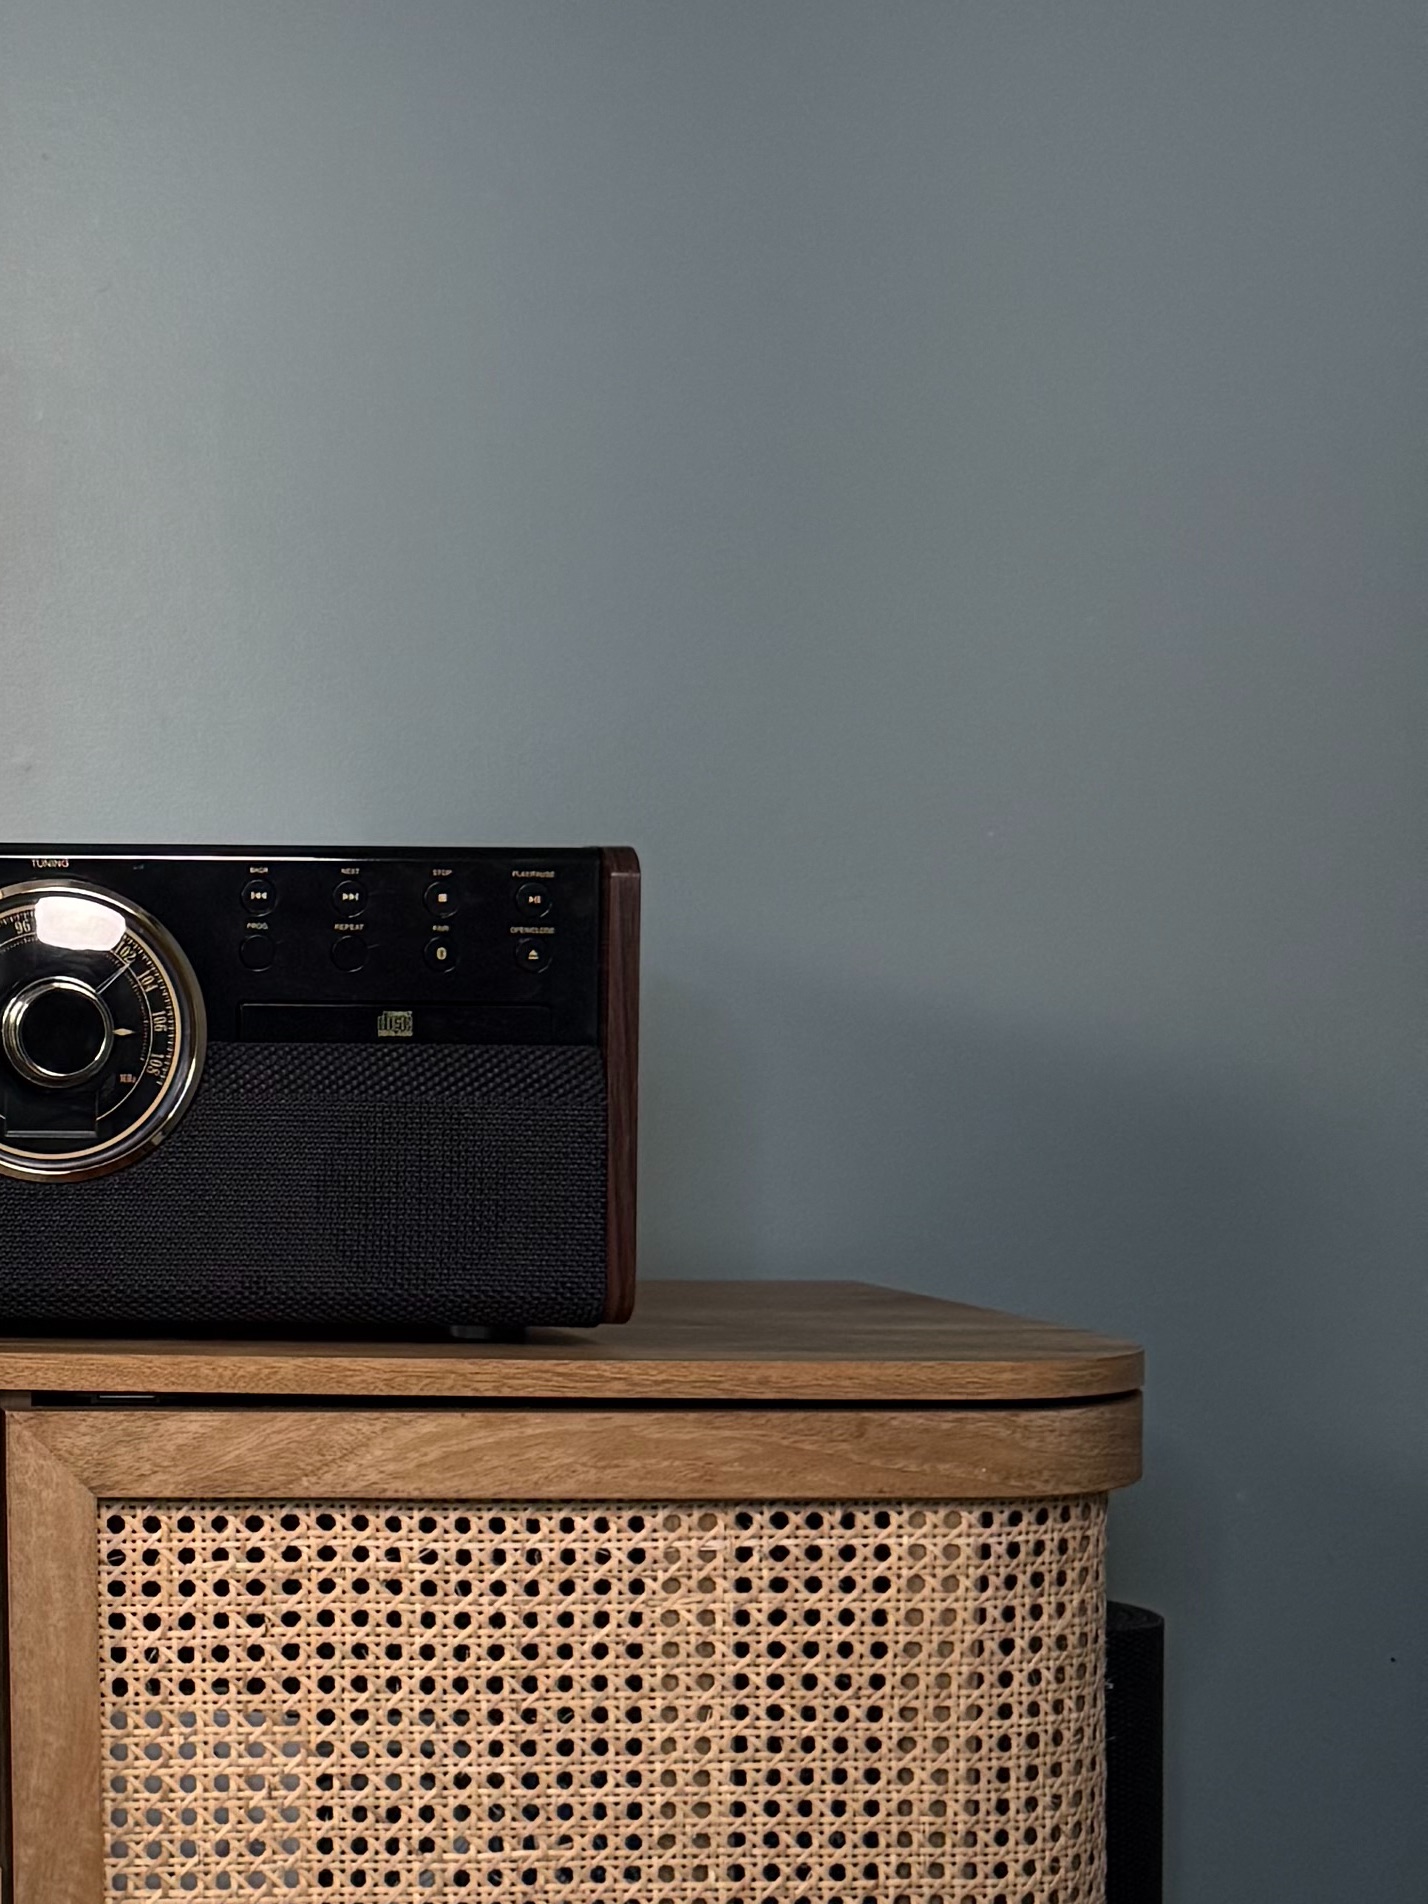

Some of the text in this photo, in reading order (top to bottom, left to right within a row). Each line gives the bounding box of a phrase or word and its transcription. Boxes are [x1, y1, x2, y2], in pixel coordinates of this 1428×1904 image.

[31, 859, 70, 868] TUNING
[13, 919, 32, 935] 96
[114, 940, 138, 965] 102
[136, 968, 159, 993] 104
[151, 1010, 168, 1033] 106
[145, 1053, 165, 1077] 108
